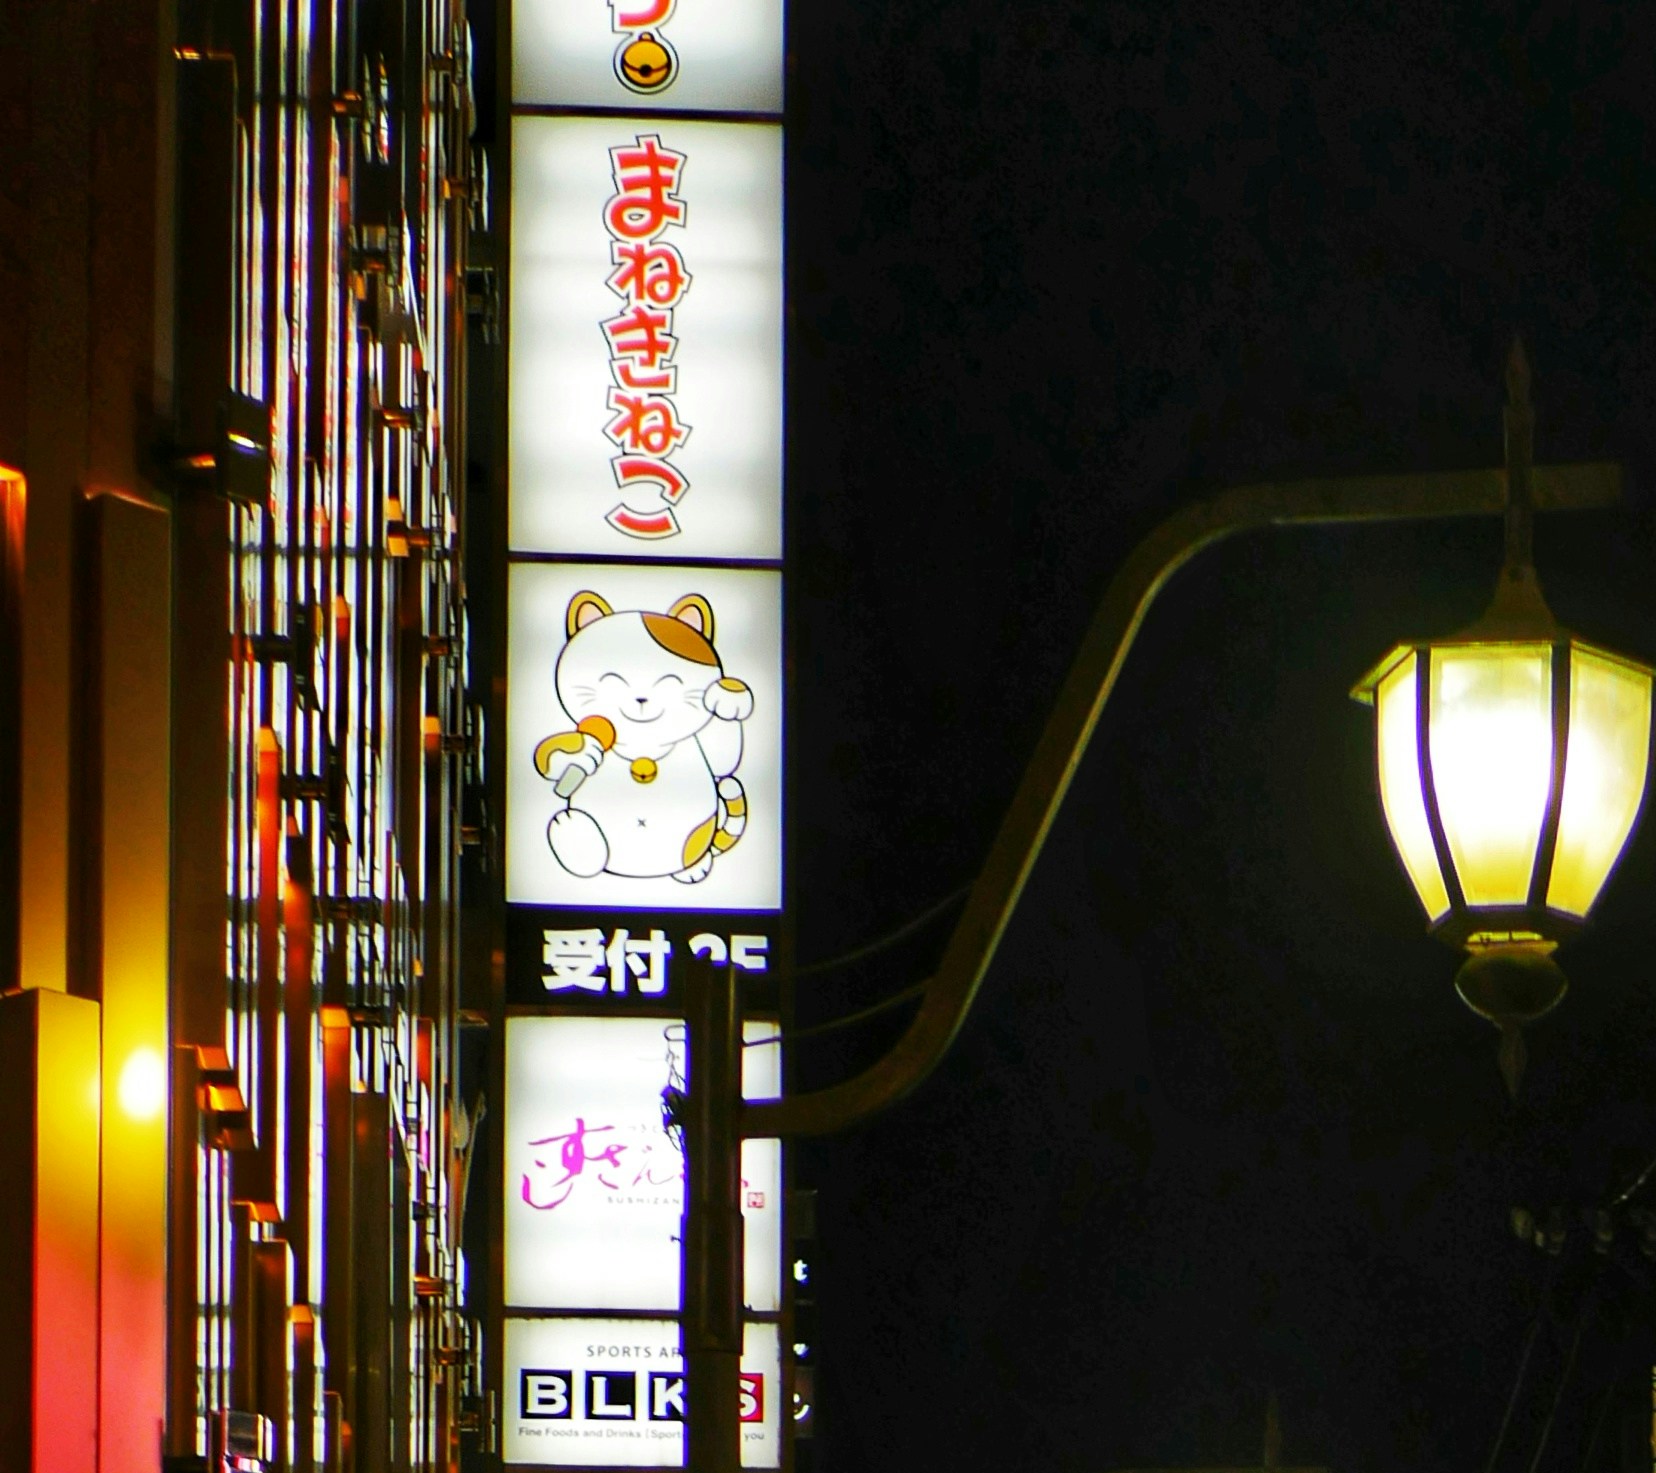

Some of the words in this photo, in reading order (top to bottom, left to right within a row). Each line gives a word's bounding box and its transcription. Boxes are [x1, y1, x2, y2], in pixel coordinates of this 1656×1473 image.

[602, 134, 692, 540] まねきねこ
[541, 928, 671, 993] 受付
[587, 1345, 652, 1358] SPORTS
[518, 1426, 542, 1437] Fine
[545, 1426, 580, 1437] Foods
[583, 1427, 602, 1437] and
[606, 1427, 641, 1438] Drinks
